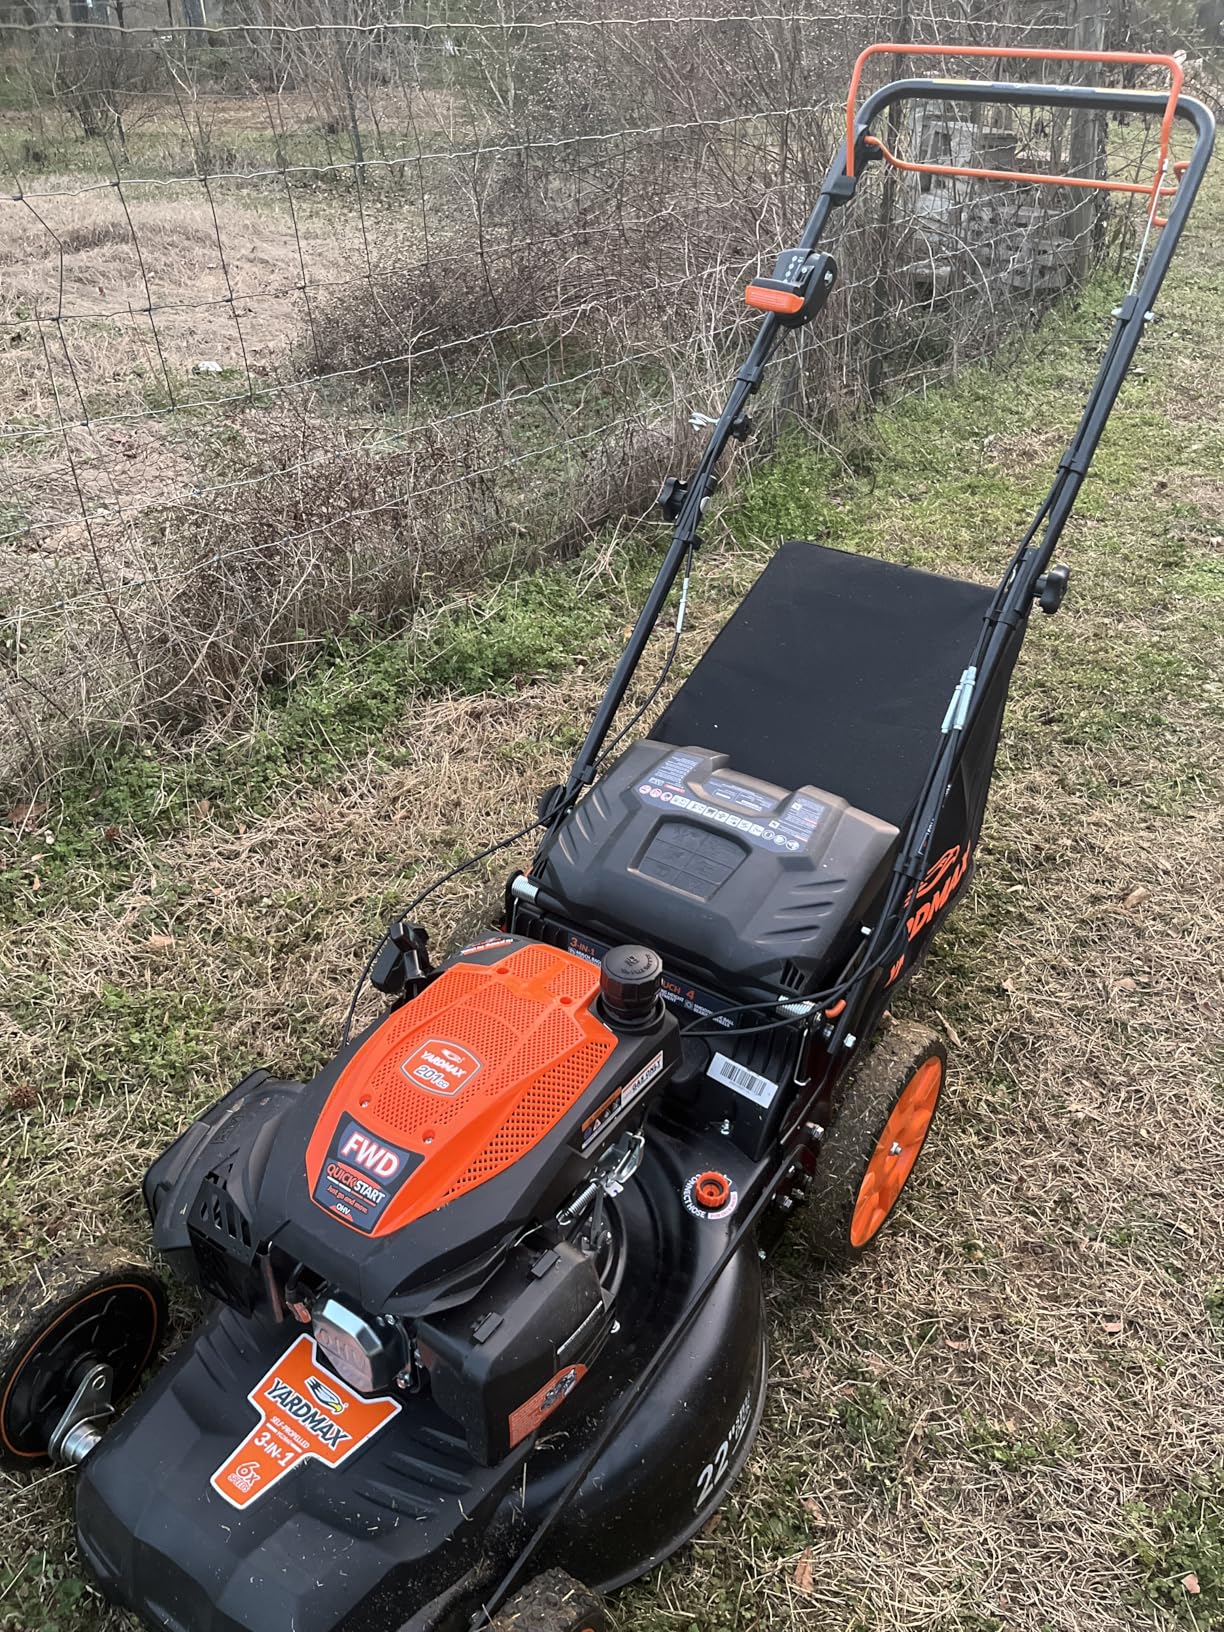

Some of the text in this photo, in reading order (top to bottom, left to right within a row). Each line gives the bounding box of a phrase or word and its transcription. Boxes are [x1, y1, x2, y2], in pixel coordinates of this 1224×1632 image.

[570, 937, 596, 956] 3-IN-1
[661, 979, 682, 994] UCH
[686, 990, 696, 1001] 4
[413, 1064, 450, 1089] 201cc
[420, 1050, 467, 1078] YARDMAX
[341, 1131, 400, 1178] FWD
[336, 1202, 351, 1215] OHV
[686, 1202, 707, 1219] HOSE
[264, 1377, 353, 1451] YARDMAX
[270, 1415, 310, 1449] SELF-PROPELLED
[254, 1431, 295, 1467] 3-IN-1
